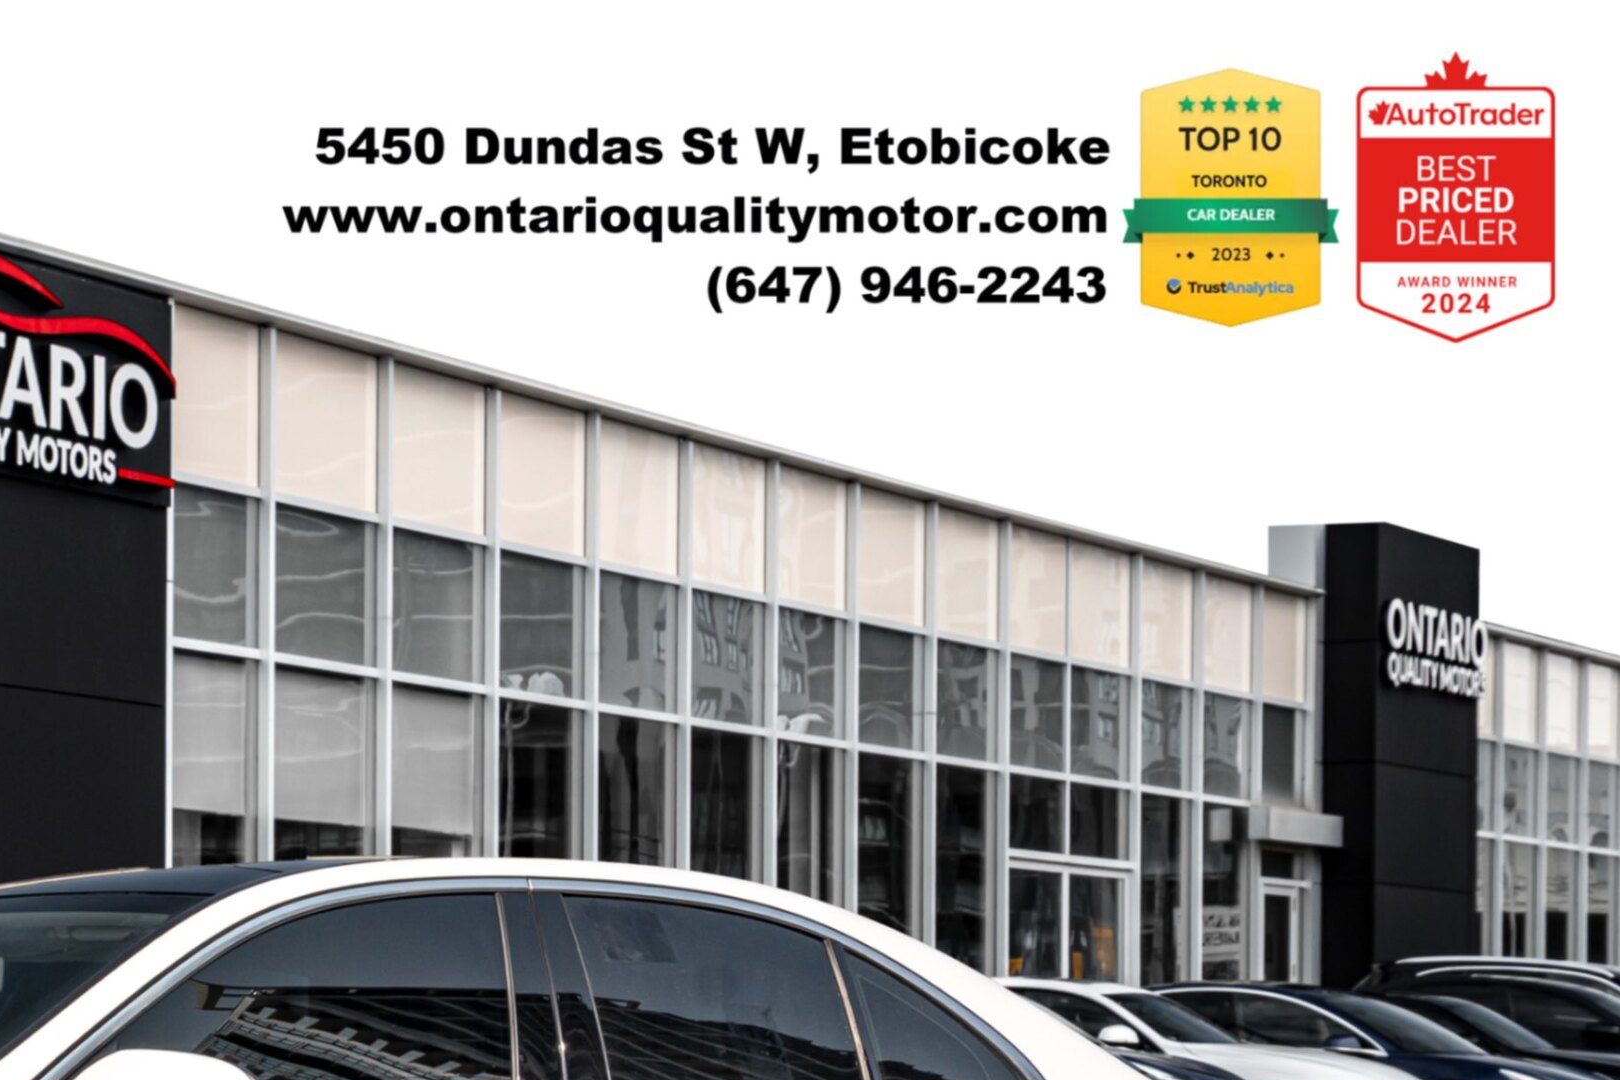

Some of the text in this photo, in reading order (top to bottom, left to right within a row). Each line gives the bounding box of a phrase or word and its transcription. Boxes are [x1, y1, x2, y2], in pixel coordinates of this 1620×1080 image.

[16, 430, 116, 484] MOTORS
[1387, 597, 1488, 667] ONTARIO
[1387, 652, 1439, 688] QUALITY
